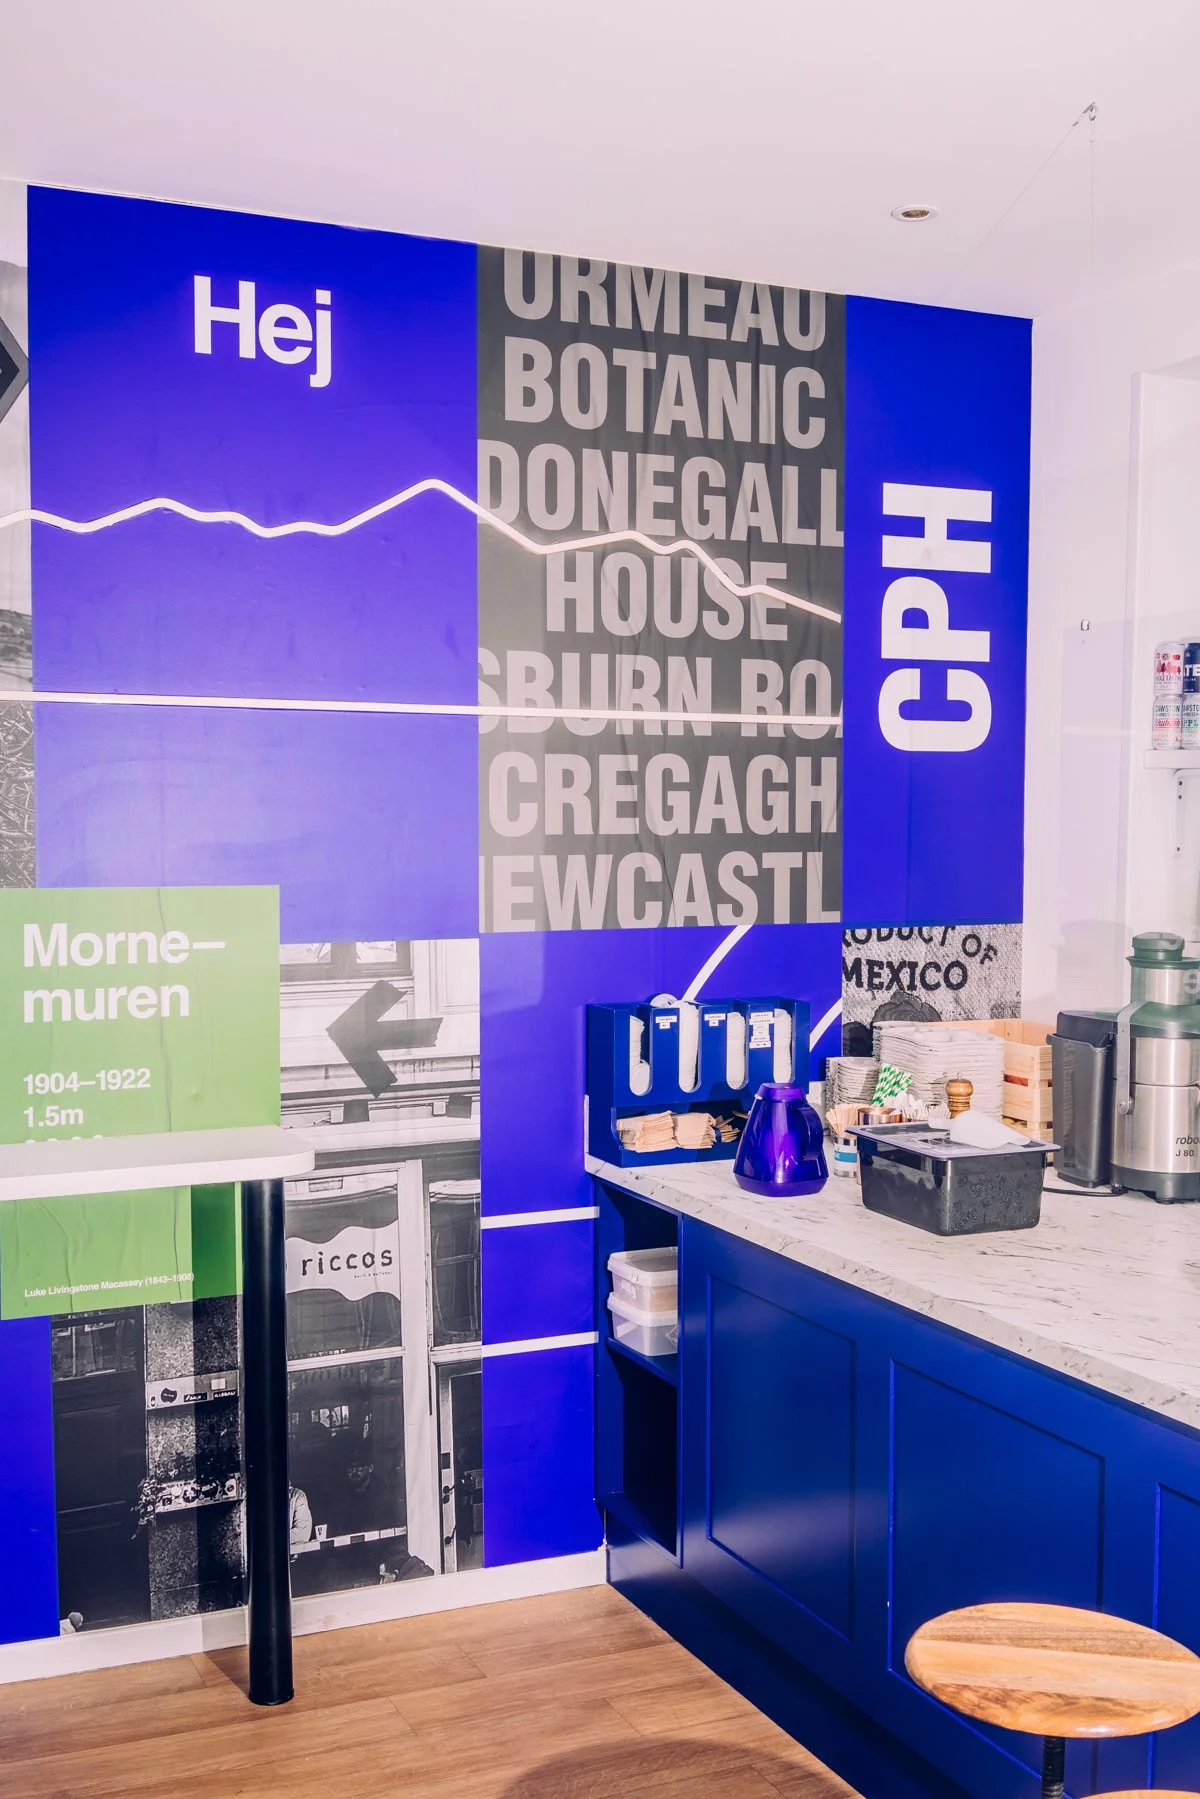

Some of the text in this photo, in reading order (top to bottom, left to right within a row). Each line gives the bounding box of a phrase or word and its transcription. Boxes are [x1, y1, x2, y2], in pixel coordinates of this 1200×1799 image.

[194, 275, 331, 388] Hej
[504, 336, 826, 449] BOTANIC
[477, 438, 844, 548] DONEGALL
[546, 551, 788, 641] HOUSE
[878, 482, 992, 752] CPH
[488, 751, 838, 837] CREGAGH
[478, 850, 841, 934] EWCASTL
[842, 957, 968, 991] MEXICO
[961, 933, 998, 966] OF
[23, 983, 190, 1023] muren
[23, 1105, 84, 1127] 1.5m
[1184, 1149, 1194, 1157] 80
[24, 1288, 47, 1298] Luke
[48, 1281, 99, 1295] Livingstone
[302, 1249, 393, 1276] riccos
